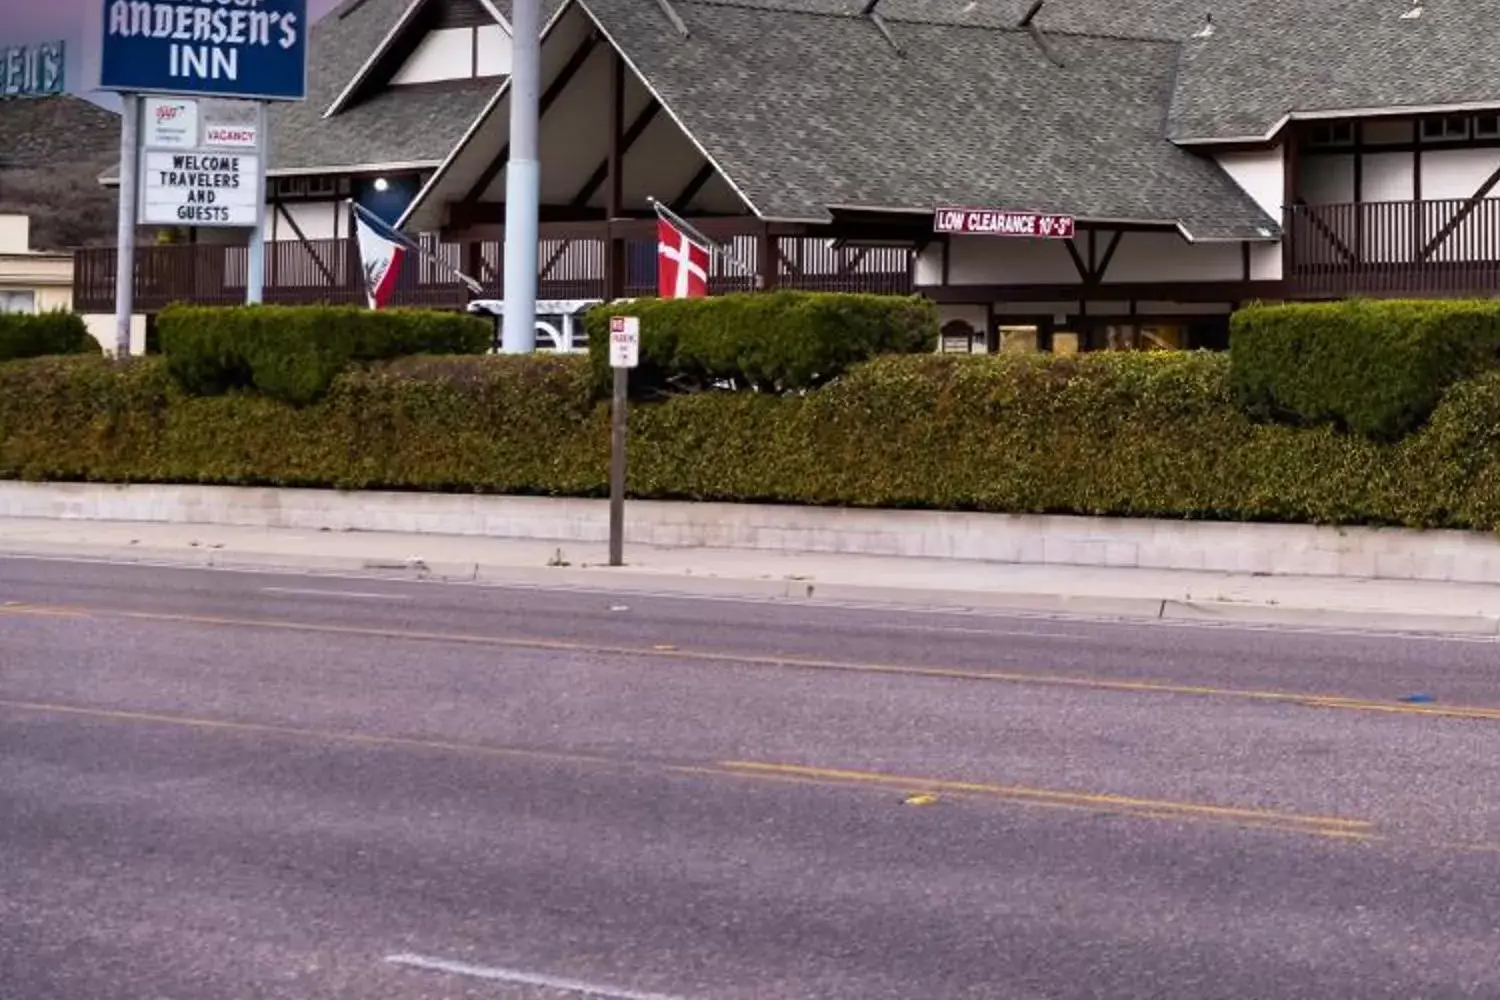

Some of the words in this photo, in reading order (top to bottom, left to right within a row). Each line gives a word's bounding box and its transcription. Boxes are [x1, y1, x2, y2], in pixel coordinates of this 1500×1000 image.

[169, 43, 238, 80] INN
[207, 130, 255, 141] VACANCY
[173, 155, 240, 172] WELCOME
[160, 171, 240, 188] TRAVELERS
[187, 189, 216, 204] AND
[177, 205, 229, 221] GUESTS
[939, 211, 964, 230] LOW
[968, 213, 1035, 233] CLEARANCE
